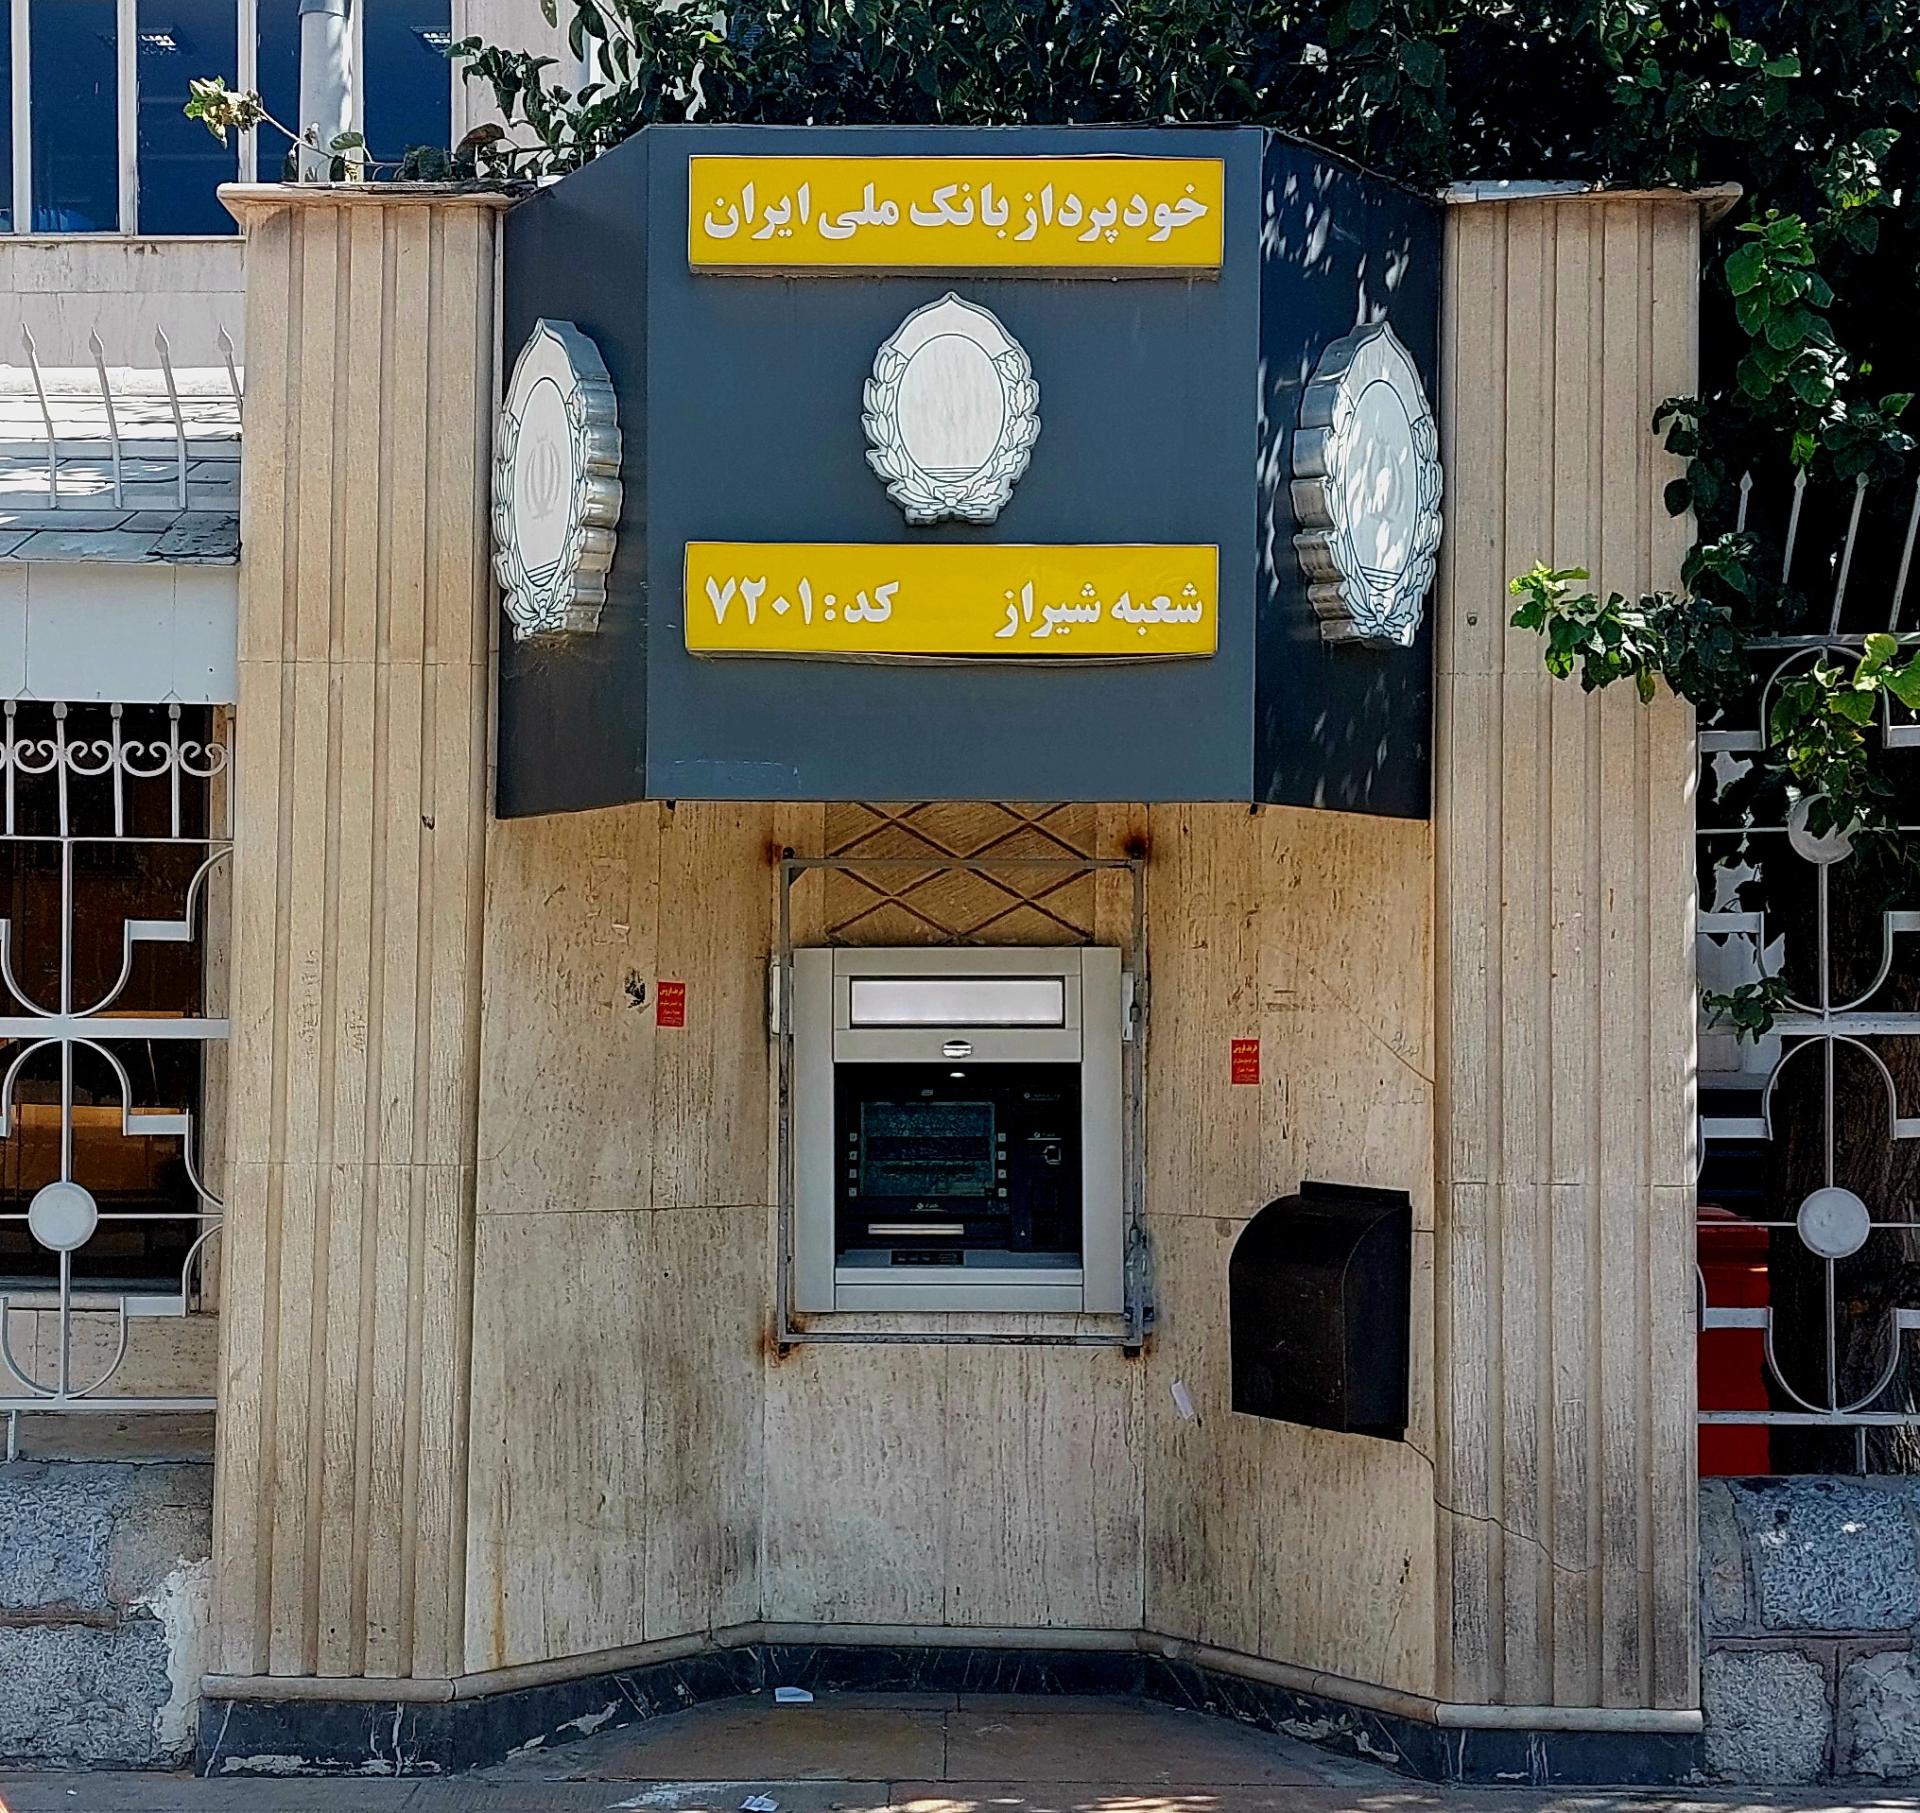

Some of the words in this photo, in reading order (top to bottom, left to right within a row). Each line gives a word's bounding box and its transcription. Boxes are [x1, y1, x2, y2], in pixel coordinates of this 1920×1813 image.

[704, 181, 811, 240] ایران
[817, 182, 900, 240] ملی
[909, 183, 1009, 240] بانک
[1013, 182, 1209, 242] خودپرداز
[994, 581, 1102, 638] شیراز
[1110, 581, 1204, 637] شعبه
